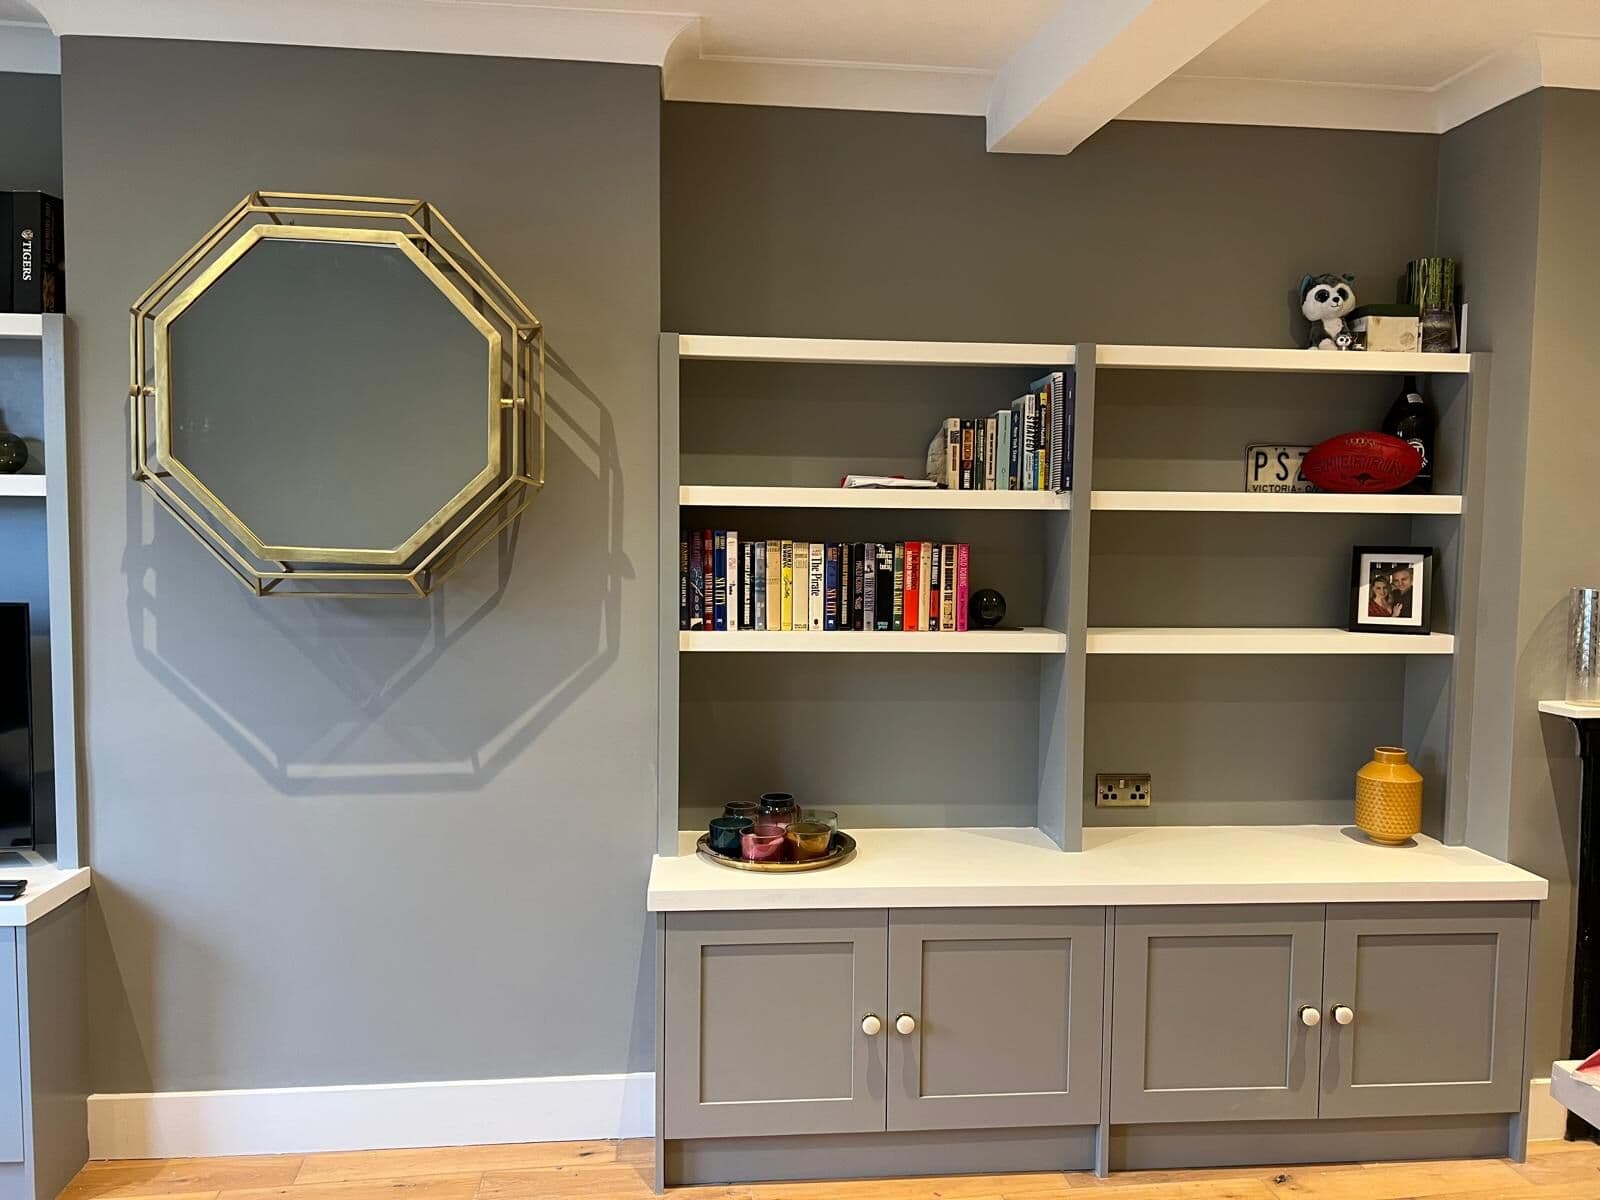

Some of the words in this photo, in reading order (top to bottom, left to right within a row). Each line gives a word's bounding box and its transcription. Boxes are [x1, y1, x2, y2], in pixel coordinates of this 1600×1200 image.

[22, 241, 32, 281] TIGERS
[1026, 415, 1036, 454] STRATEGY
[811, 557, 822, 573] The
[959, 546, 968, 567] HAROLD
[715, 577, 726, 589] SIN
[811, 573, 822, 598] Pirate
[959, 567, 968, 588] ROBBINS
[715, 588, 726, 606] CITY
[826, 588, 837, 600] SIN
[826, 600, 837, 617] CITY
